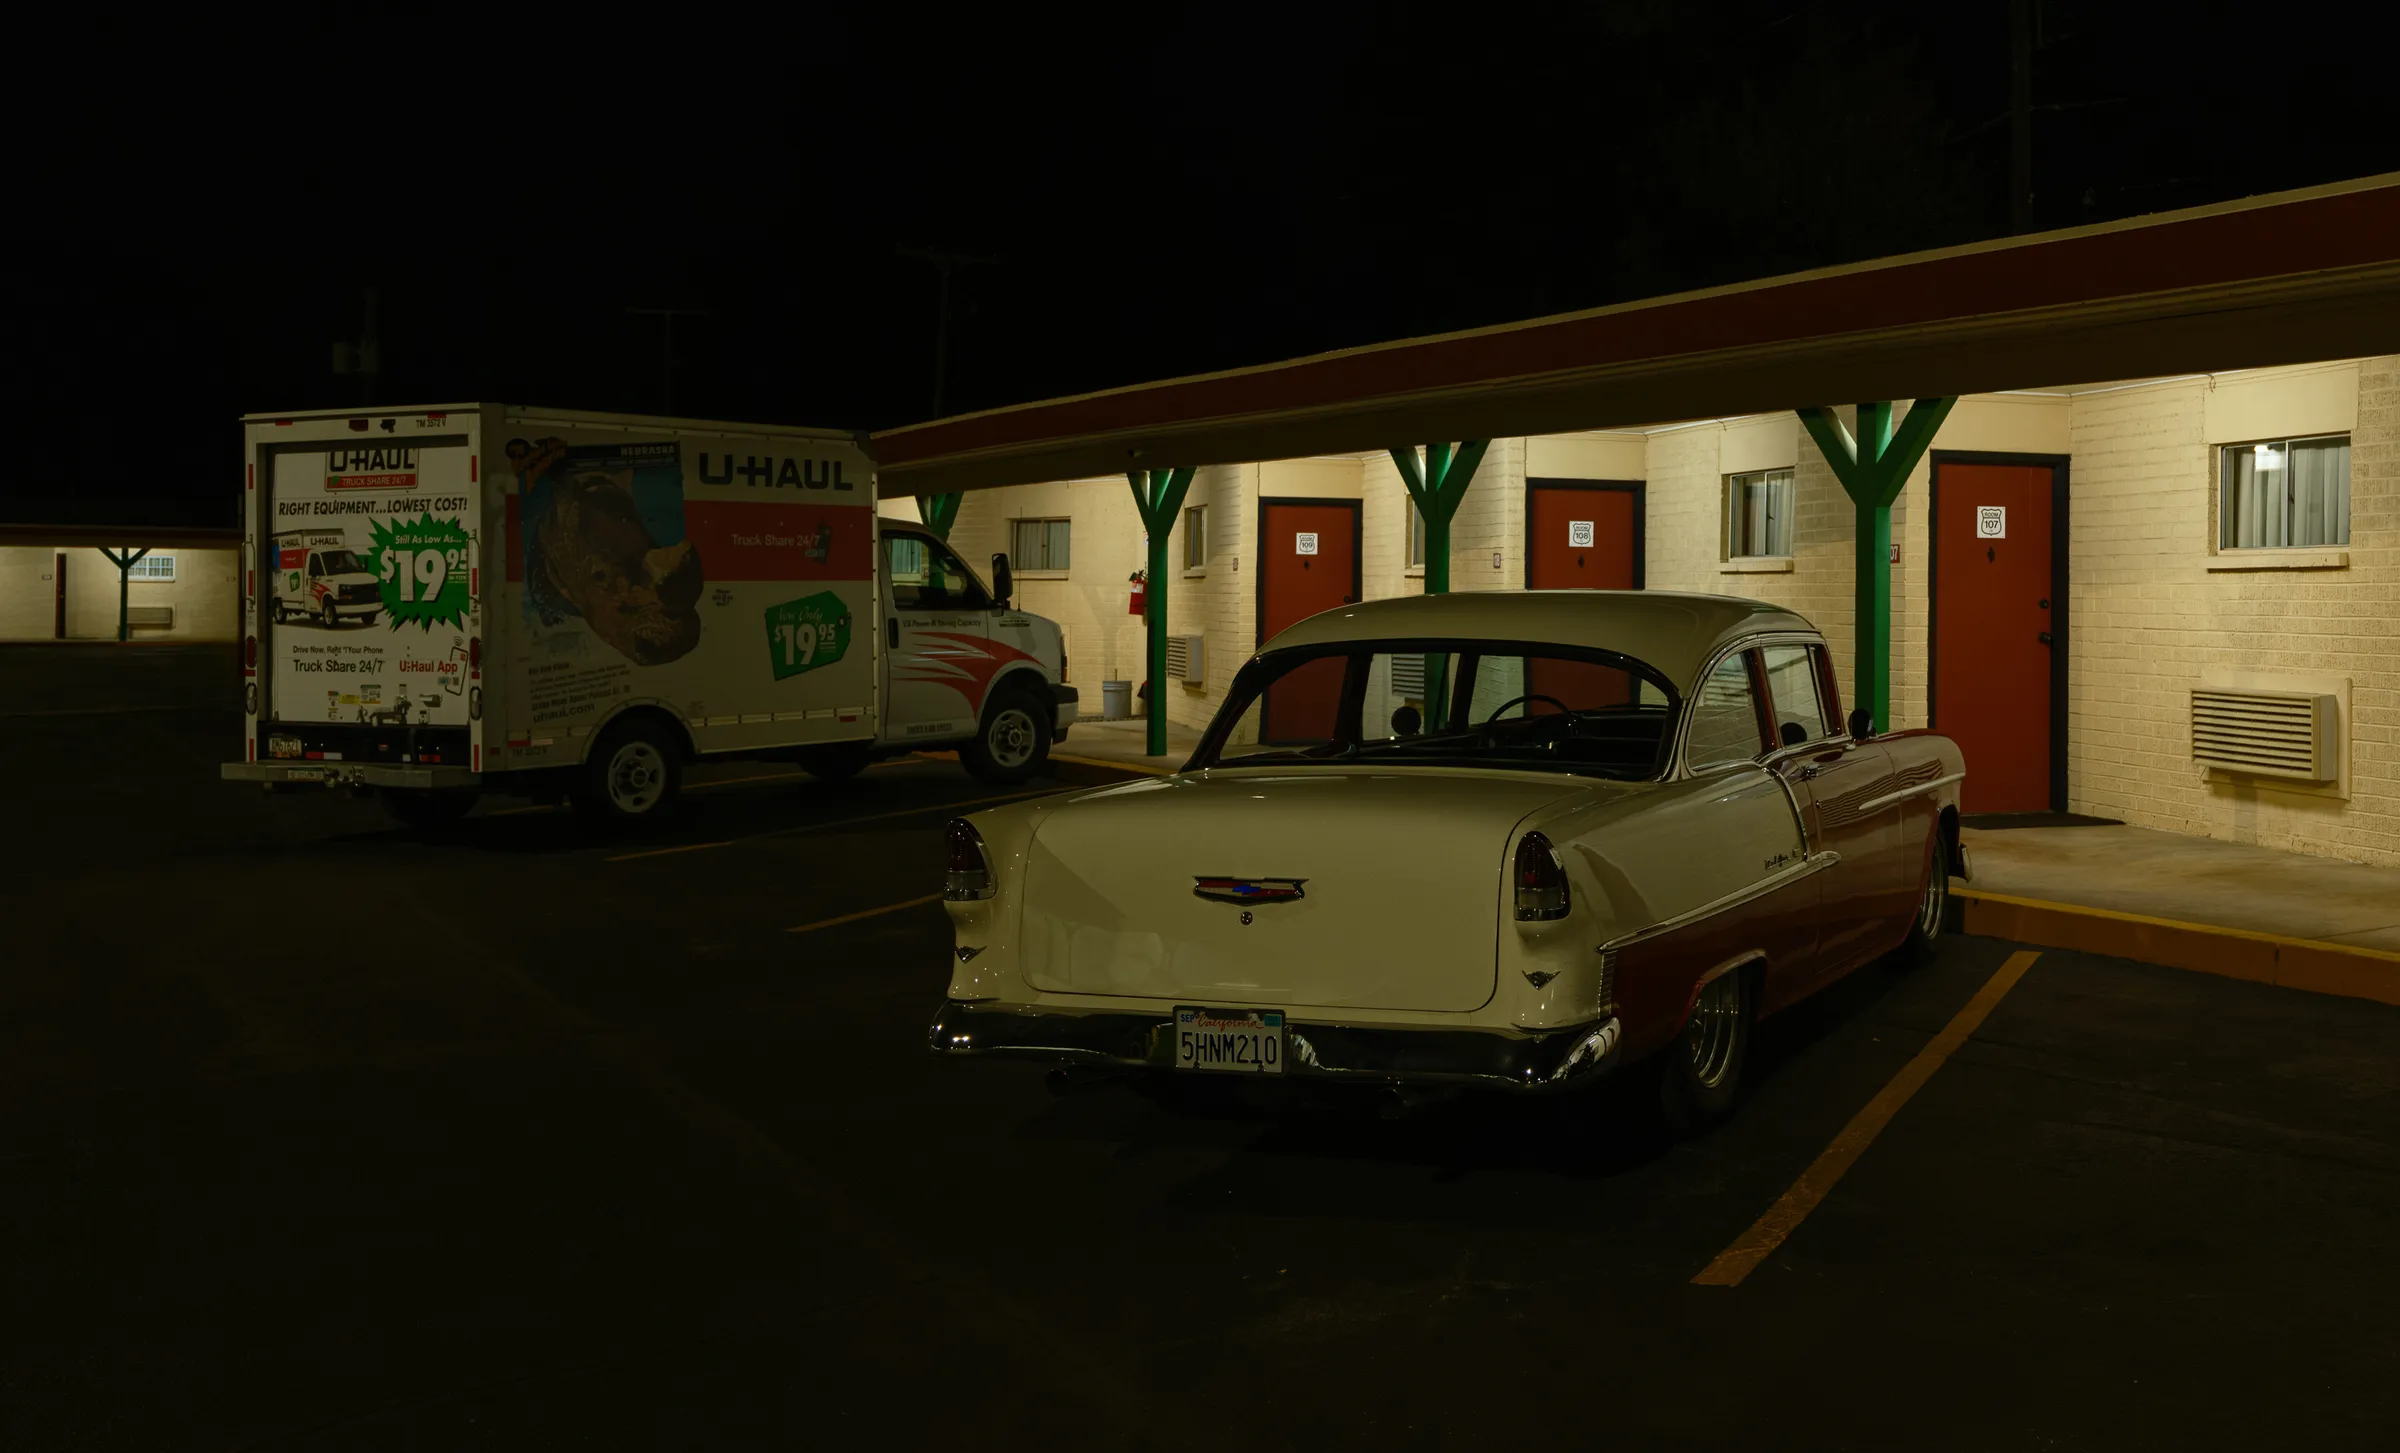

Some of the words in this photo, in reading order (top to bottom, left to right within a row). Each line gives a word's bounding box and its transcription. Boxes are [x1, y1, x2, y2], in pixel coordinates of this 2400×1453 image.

[620, 445, 675, 458] NEBRASKA
[341, 477, 365, 487] TRUCK
[366, 477, 390, 486] SHARE
[279, 502, 311, 516] RIGHT
[434, 497, 468, 512] COST!
[1984, 520, 1999, 529] 107
[395, 534, 410, 545] Still
[411, 535, 422, 544] As
[424, 535, 442, 544] Low
[731, 533, 763, 547] Truck
[764, 534, 795, 547] Share
[796, 533, 822, 549] 24/7
[1575, 532, 1589, 540] 108
[797, 604, 824, 625] Only
[293, 646, 308, 654] Drive
[363, 646, 384, 654] Phone
[293, 659, 323, 672] Truck
[325, 659, 357, 673] Share
[358, 658, 384, 675] 24/7
[437, 660, 458, 675] App
[533, 703, 595, 724] uhaul.com
[1180, 1013, 1195, 1023] SEP
[1196, 1012, 1265, 1032] California
[1181, 1031, 1277, 1065] 5HNM210
